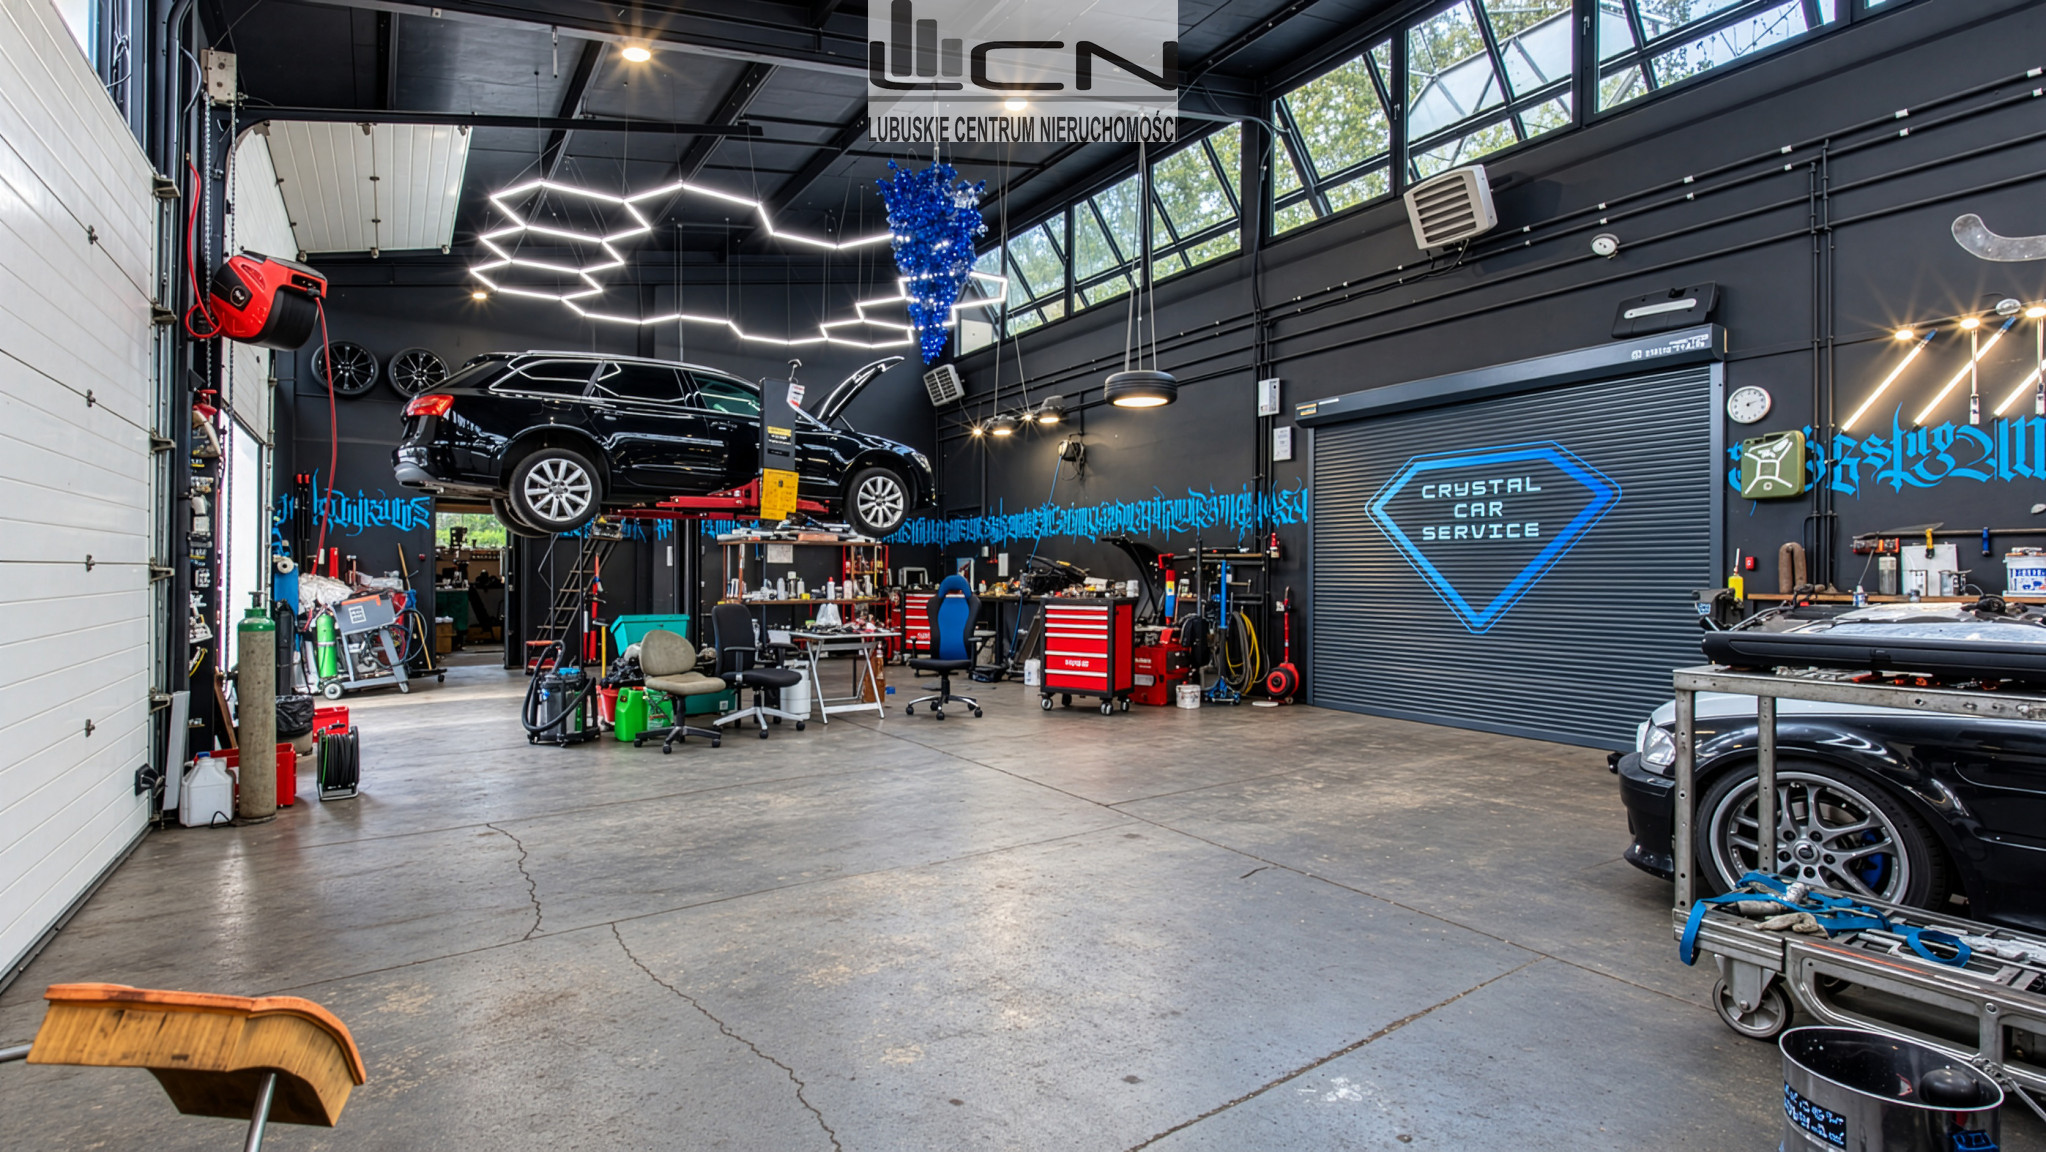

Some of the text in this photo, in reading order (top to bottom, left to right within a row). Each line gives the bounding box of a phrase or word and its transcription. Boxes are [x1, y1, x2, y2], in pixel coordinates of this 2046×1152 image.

[1422, 476, 1541, 499] CRYSTAL
[1453, 501, 1503, 518] CAR
[1422, 522, 1540, 541] SERVICE
